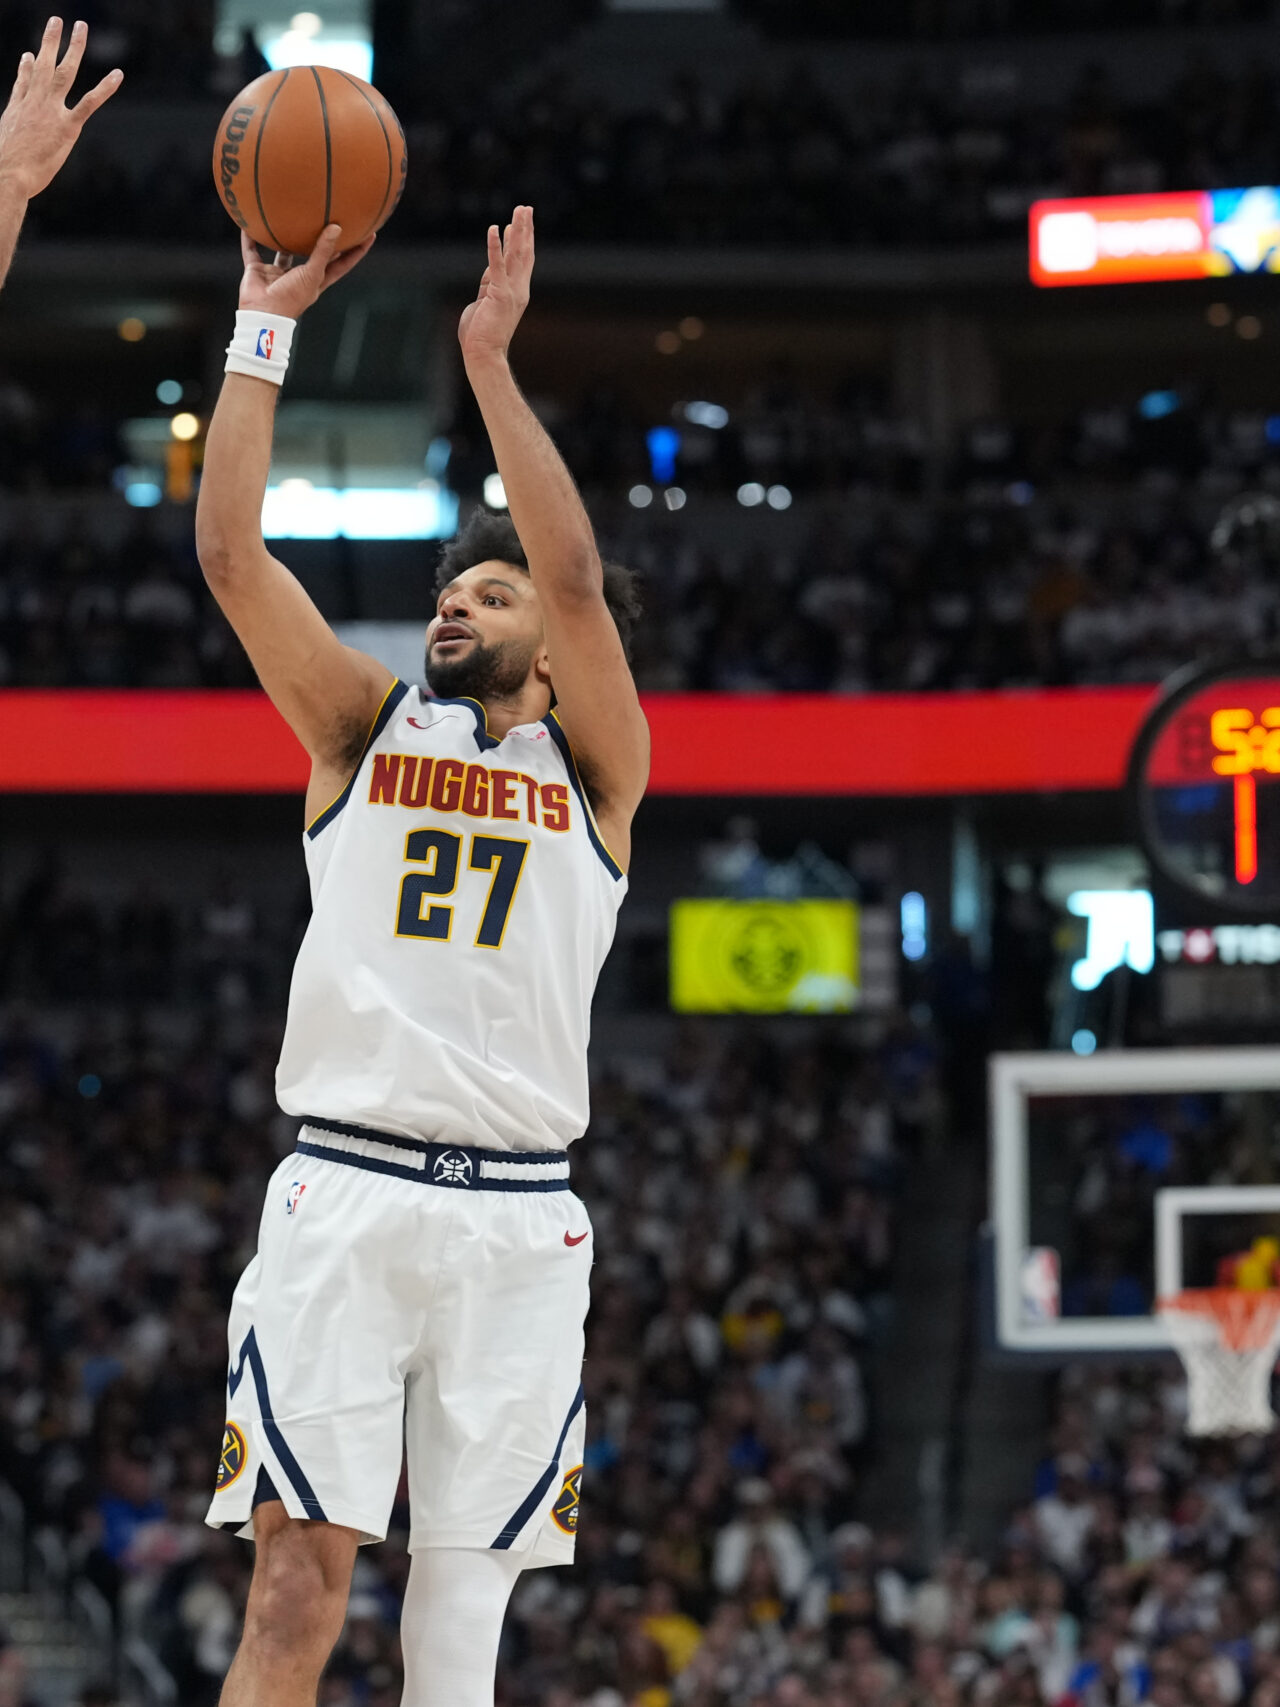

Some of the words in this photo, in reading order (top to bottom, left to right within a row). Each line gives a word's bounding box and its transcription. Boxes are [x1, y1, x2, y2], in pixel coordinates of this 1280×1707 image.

[220, 104, 258, 229] Wilson
[368, 753, 571, 834] NUGGETS
[393, 826, 532, 951] 27
